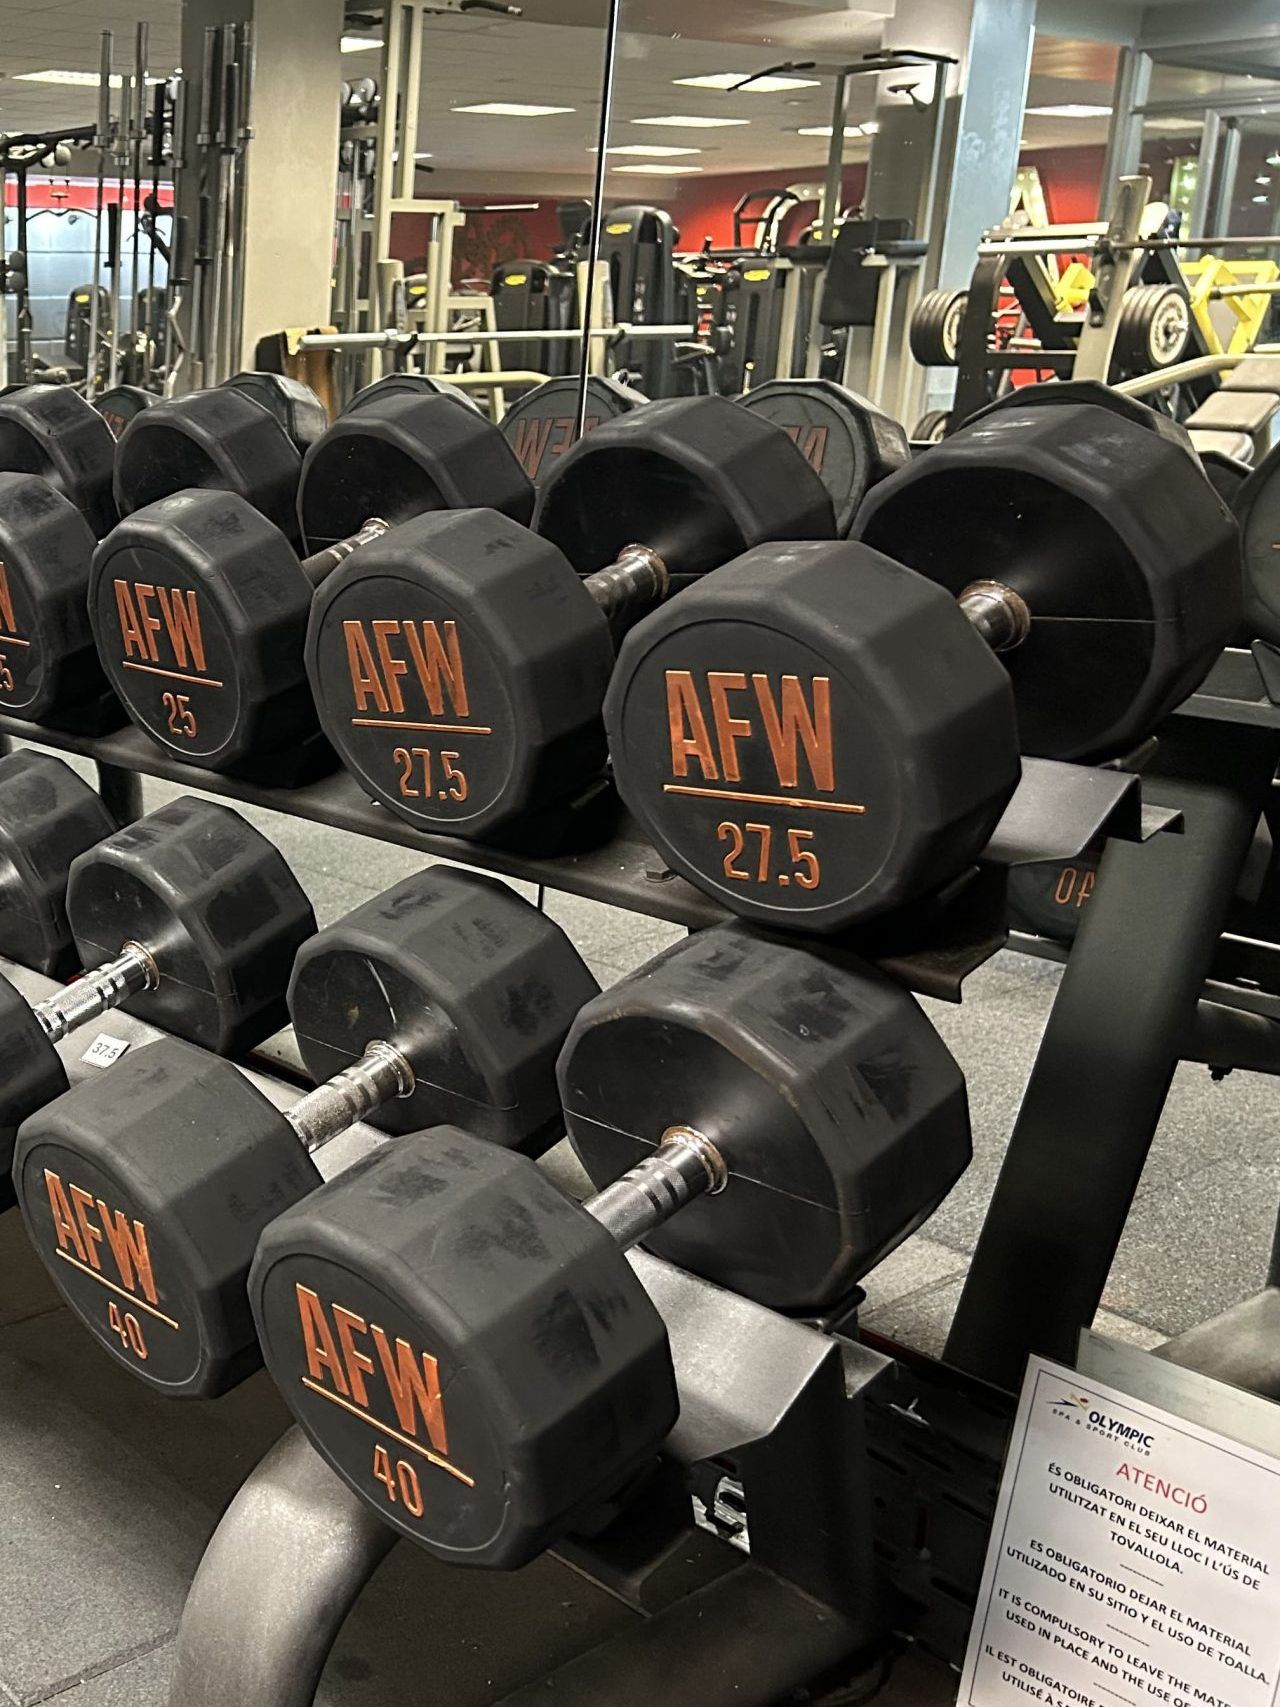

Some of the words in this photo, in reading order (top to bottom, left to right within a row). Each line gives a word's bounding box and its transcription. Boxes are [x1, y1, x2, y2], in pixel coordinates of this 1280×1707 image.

[114, 579, 207, 672] AFW
[343, 620, 469, 718] AFW
[162, 691, 198, 739] 25
[665, 669, 836, 793] AFW
[393, 746, 469, 803] 27.5
[717, 821, 821, 890] 27.5
[92, 1043, 119, 1059] 37.5
[43, 1167, 160, 1306] AFW
[108, 1300, 149, 1361] 40
[296, 1281, 449, 1456] AFW
[1052, 1408, 1071, 1421] SPA
[1086, 1423, 1120, 1442] SPORT
[1124, 1441, 1151, 1457] CLUB
[1088, 1411, 1155, 1449] OLYMPIC
[372, 1443, 425, 1518] 40
[1116, 1463, 1208, 1514] ATENCIÓ
[1048, 1462, 1062, 1477] ÉS
[1064, 1471, 1136, 1512] OBLIGATORI
[1139, 1506, 1185, 1535] DEIXAR
[1187, 1529, 1201, 1543] EL
[1204, 1536, 1270, 1575] MATERIAL
[1048, 1482, 1108, 1517] UTILITZAT
[1109, 1512, 1126, 1527] EN
[1128, 1521, 1142, 1535] EL
[1144, 1528, 1169, 1546] SEU
[1171, 1541, 1203, 1563] LLOC
[1242, 1575, 1261, 1591] DE
[1110, 1531, 1184, 1575] TOVALLOLA.
[1006, 1546, 1067, 1583] UTILIZADO
[1069, 1578, 1086, 1593] EN
[1088, 1587, 1104, 1602] SU
[1106, 1597, 1138, 1619] SITIO
[1141, 1613, 1149, 1624] Y
[1151, 1619, 1165, 1633] EL
[1168, 1626, 1194, 1647] USO
[1197, 1642, 1215, 1658] DE
[1218, 1651, 1270, 1686] TOALLA.
[1030, 1539, 1044, 1553] ES
[1046, 1547, 1127, 1594] OBLIGATORIO
[1129, 1589, 1168, 1615] DEJAR
[1170, 1609, 1183, 1623] EL
[1186, 1617, 1252, 1657] MATERIAL
[985, 1644, 995, 1657] IL
[997, 1651, 1018, 1667] EST
[1019, 1663, 1096, 1707] OBLIGATOIRE
[999, 1588, 1010, 1600] IT
[1011, 1594, 1022, 1607] IS
[1024, 1601, 1105, 1649] COMPULSORY
[1108, 1643, 1124, 1659] TO
[1126, 1654, 1165, 1680] LEAVE
[1167, 1674, 1192, 1694] THE
[1006, 1610, 1036, 1632] USED
[1038, 1627, 1051, 1641] IN
[1054, 1635, 1090, 1661] PLACE
[1091, 1656, 1119, 1675] AND
[1121, 1669, 1145, 1689] THE
[1147, 1683, 1171, 1703] USE
[1002, 1671, 1043, 1700] UTILISÉ
